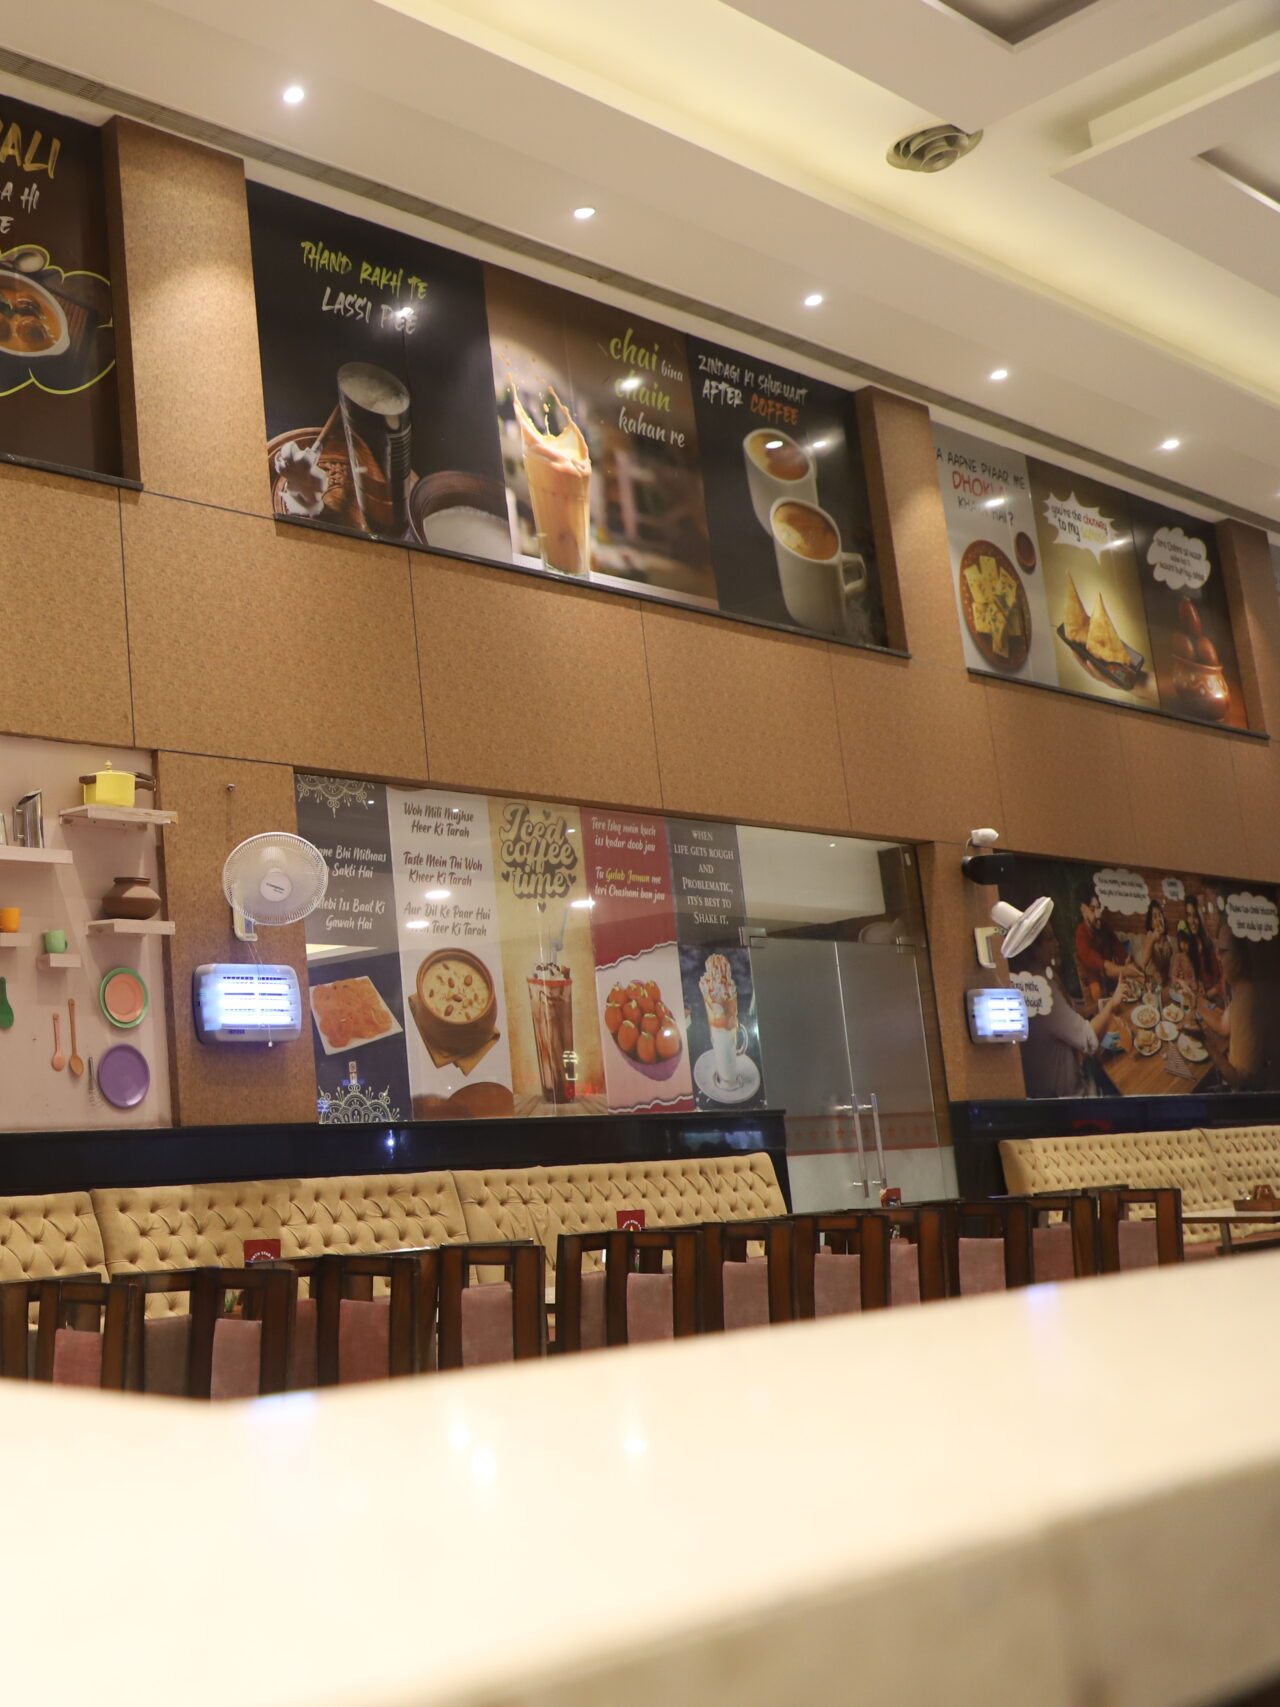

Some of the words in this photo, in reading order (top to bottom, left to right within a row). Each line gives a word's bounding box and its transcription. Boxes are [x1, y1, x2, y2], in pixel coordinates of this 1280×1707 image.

[20, 183, 40, 213] HI
[301, 241, 352, 275] THAND
[360, 261, 403, 299] RAKH
[408, 276, 428, 300] TE
[322, 286, 372, 324] LASSI
[610, 328, 659, 371] chai
[661, 360, 683, 381] bina
[698, 355, 740, 384] ZINDAGI
[744, 368, 755, 388] KI
[614, 369, 670, 412] chain
[702, 379, 743, 408] AFTER
[750, 393, 799, 425] COFFEE
[618, 405, 665, 442] kahan
[670, 430, 685, 448] re
[947, 452, 977, 473] AAPNE
[404, 802, 422, 816] Woh
[424, 804, 442, 819] Mili
[444, 807, 474, 824] Mujhse
[411, 820, 432, 834] Heer
[434, 821, 444, 836] Ki
[446, 823, 470, 838] Tarah
[499, 803, 568, 845] Iced
[592, 816, 606, 830] Tere
[640, 824, 656, 837] kuch
[595, 834, 604, 846] iss
[627, 839, 643, 850] doob
[643, 840, 656, 855] jau
[691, 829, 713, 841] WHEN
[335, 845, 352, 859] Bhi
[353, 848, 387, 863] Mithaas
[403, 851, 424, 865] Taste
[425, 853, 447, 868] Mein
[449, 855, 462, 870] Thi
[464, 857, 483, 871] Woh
[501, 836, 577, 873] coffee
[674, 844, 689, 855] LIFE
[690, 846, 707, 857] GETS
[708, 848, 734, 860] ROUGH
[332, 862, 356, 878] Sakti
[358, 865, 374, 878] Hai
[409, 868, 434, 883] Kheer
[436, 870, 446, 885] Ki
[449, 872, 472, 886] Tarah
[595, 866, 604, 879] Tu
[606, 867, 625, 882] Gulab
[627, 869, 650, 884] Jamun
[698, 864, 714, 874] AND
[513, 864, 570, 899] time
[640, 887, 653, 899] ban
[704, 897, 721, 908] BEST
[722, 898, 732, 909] TO
[318, 895, 337, 910] lebi
[338, 897, 350, 911] Iss
[352, 898, 374, 913] Baat
[375, 900, 386, 914] Ki
[404, 901, 421, 915] Aur
[424, 903, 438, 917] Dil
[440, 904, 450, 919] Ke
[452, 905, 473, 919] Paar
[475, 907, 491, 920] Hui
[325, 914, 355, 931] Gawah
[357, 916, 373, 930] Hai
[432, 920, 449, 934] Teer
[451, 922, 461, 937] Ki
[463, 922, 487, 937] Tarah
[719, 914, 729, 925] IT.
